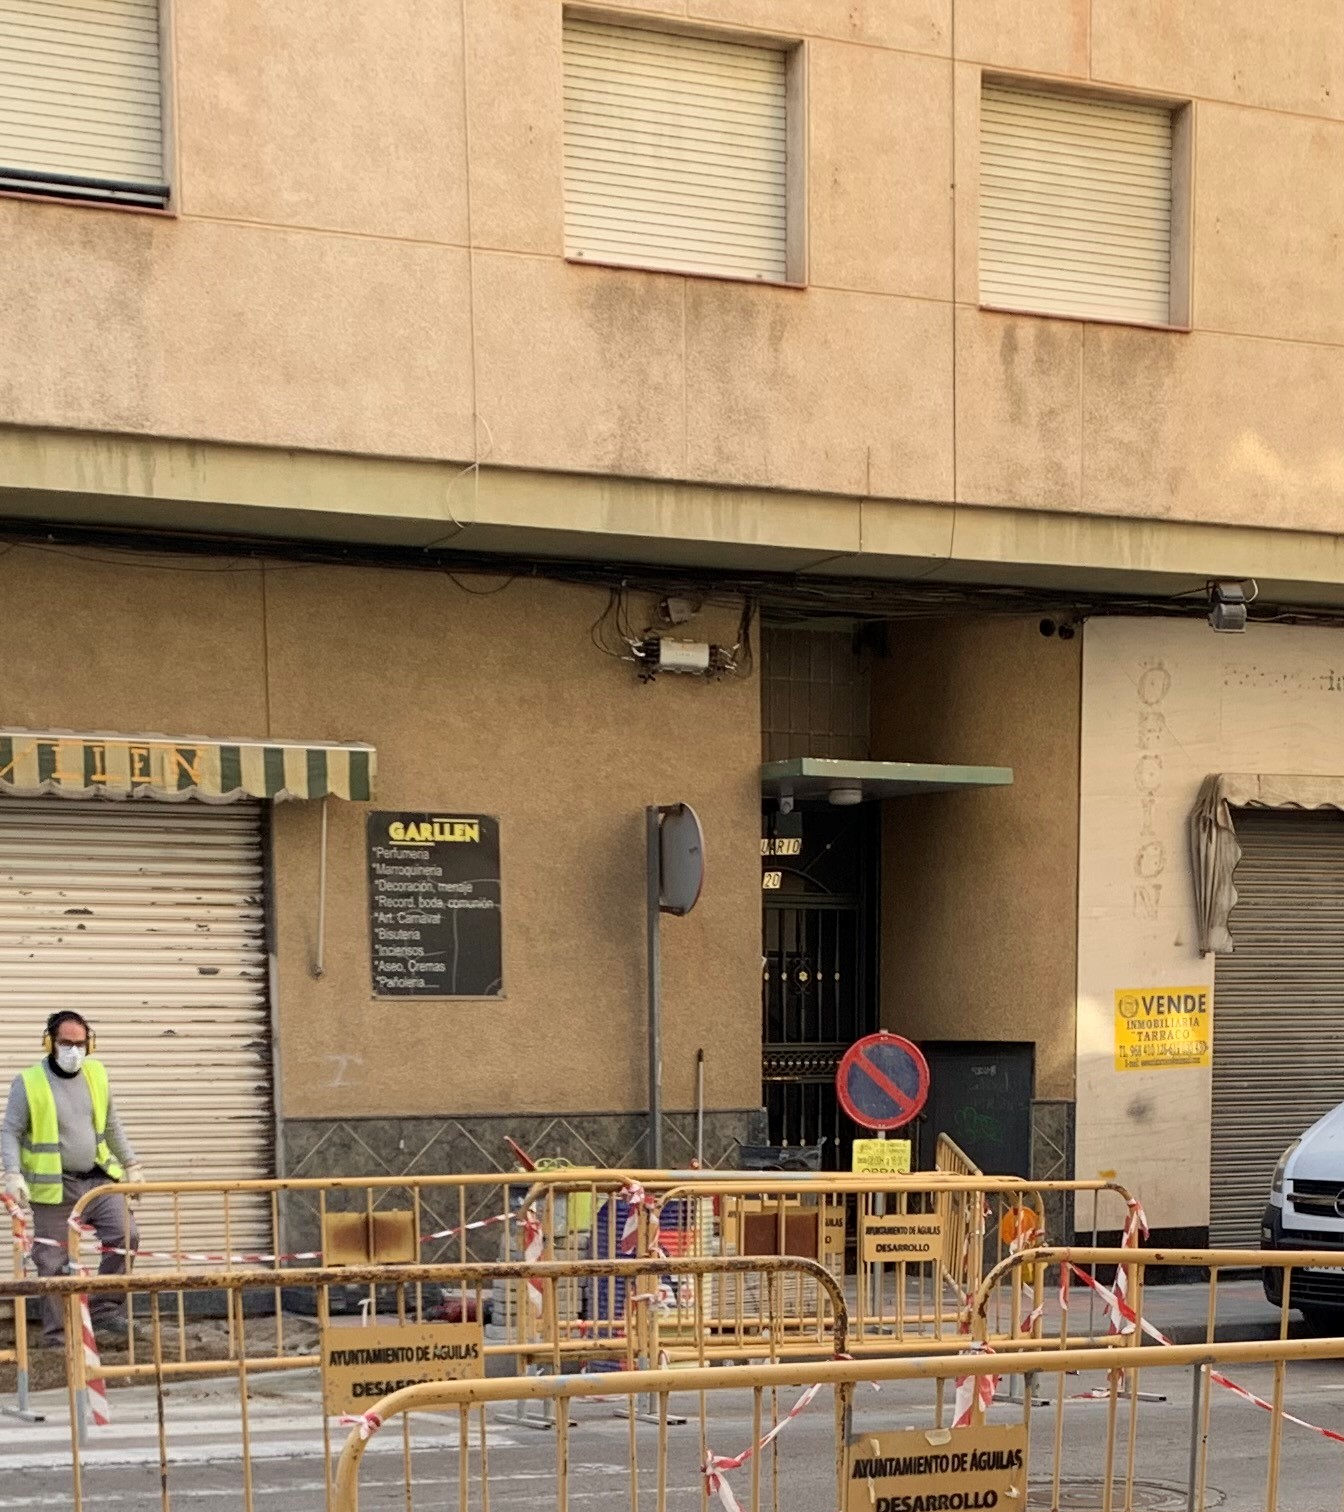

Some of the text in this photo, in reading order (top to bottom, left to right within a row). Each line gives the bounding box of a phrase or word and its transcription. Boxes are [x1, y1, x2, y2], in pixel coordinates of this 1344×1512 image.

[388, 820, 480, 843] GARLLEN
[764, 873, 780, 888] 20
[1141, 994, 1206, 1015] VENDE
[1126, 1017, 1201, 1030] INMOBILIARIA
[865, 1226, 908, 1236] AYUNTAMIENTO
[909, 1226, 916, 1235] DE
[875, 1244, 930, 1253] DESARROLLO
[329, 1342, 479, 1367] AYUNTAMIENTO DE ÁGUILAS
[851, 1448, 1022, 1479] AYUNTAMIENTO DE ÁGUILAS
